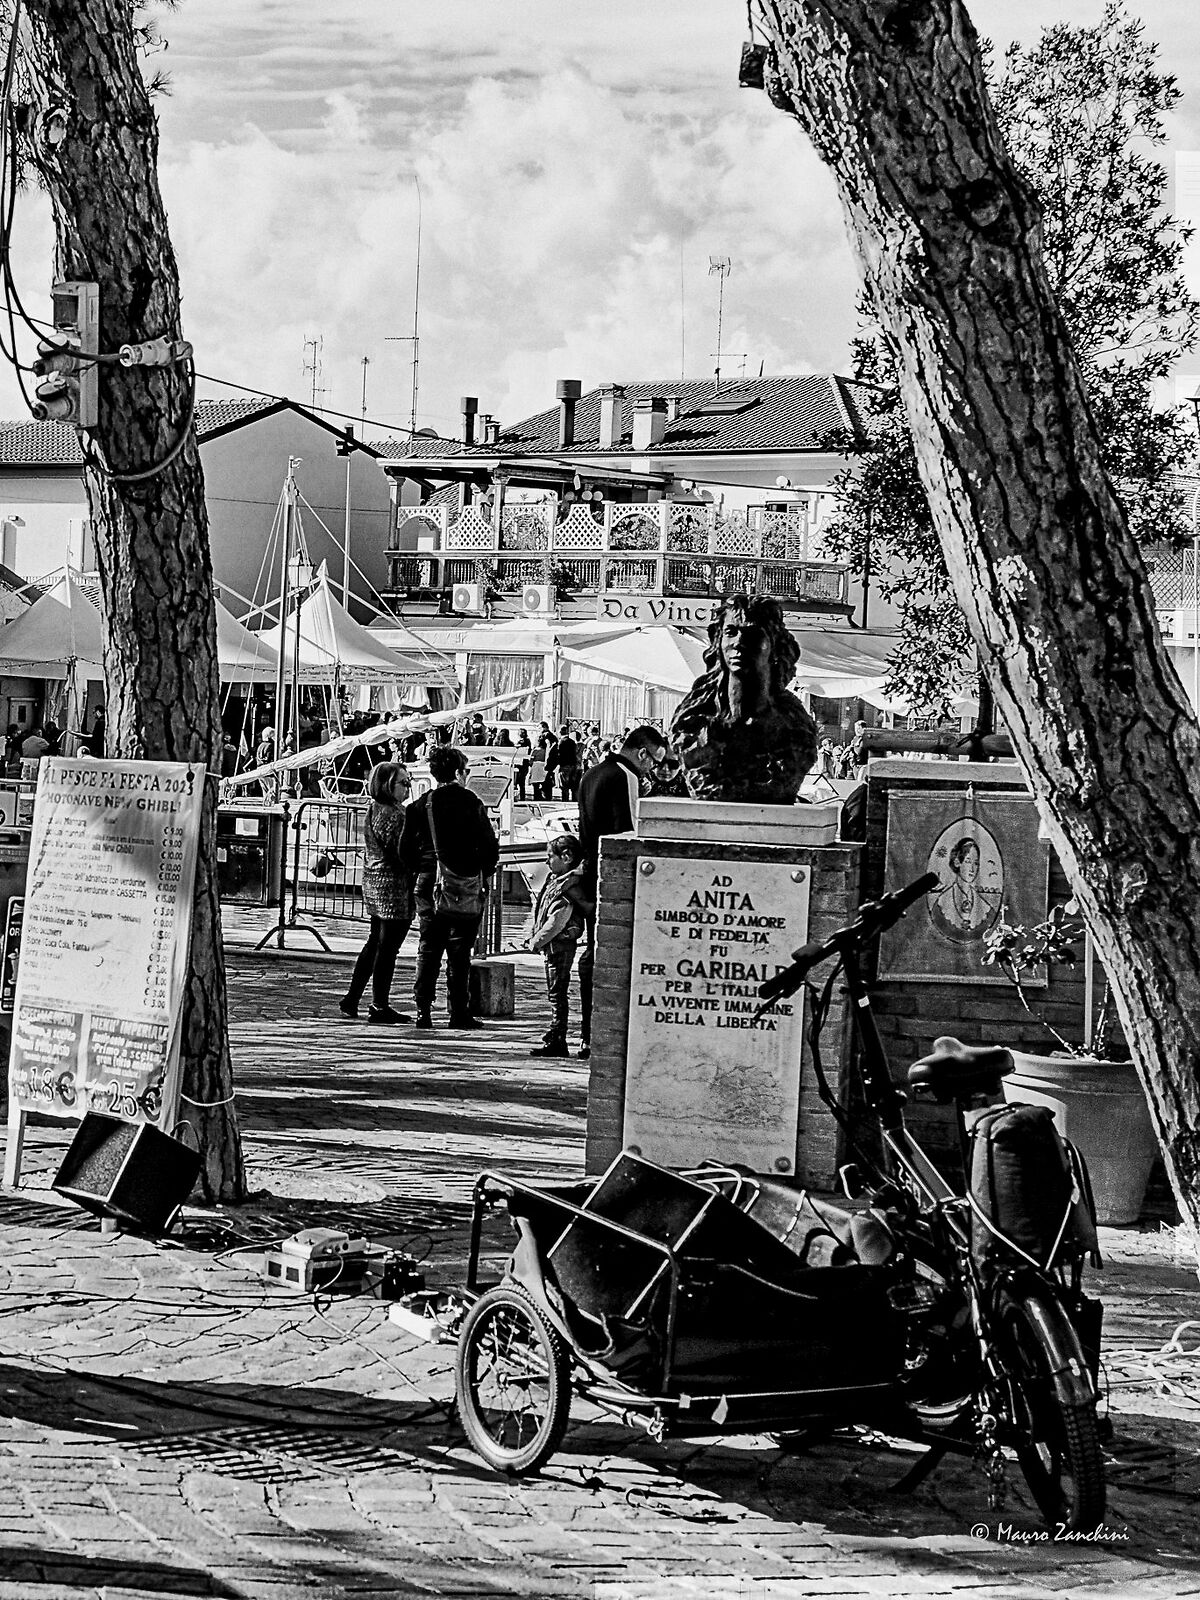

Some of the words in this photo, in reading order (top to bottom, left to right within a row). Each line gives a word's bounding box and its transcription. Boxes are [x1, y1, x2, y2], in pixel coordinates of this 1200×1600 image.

[601, 599, 639, 618] Da
[647, 599, 718, 621] Vinci
[61, 770, 97, 787] PESCE
[120, 774, 160, 792] FESTA
[711, 875, 733, 887] AD
[686, 890, 755, 911] ANITA
[654, 910, 719, 925] SIMBOLO
[723, 914, 786, 929] D'AMORE
[671, 926, 680, 938] E
[688, 927, 702, 939] DI
[710, 945, 728, 957] FU
[640, 963, 666, 976] PER
[665, 980, 692, 993] PER
[706, 983, 760, 998] L'ITALI
[638, 994, 657, 1007] LA
[661, 995, 720, 1011] VIVENTE
[655, 1011, 705, 1026] DELLA
